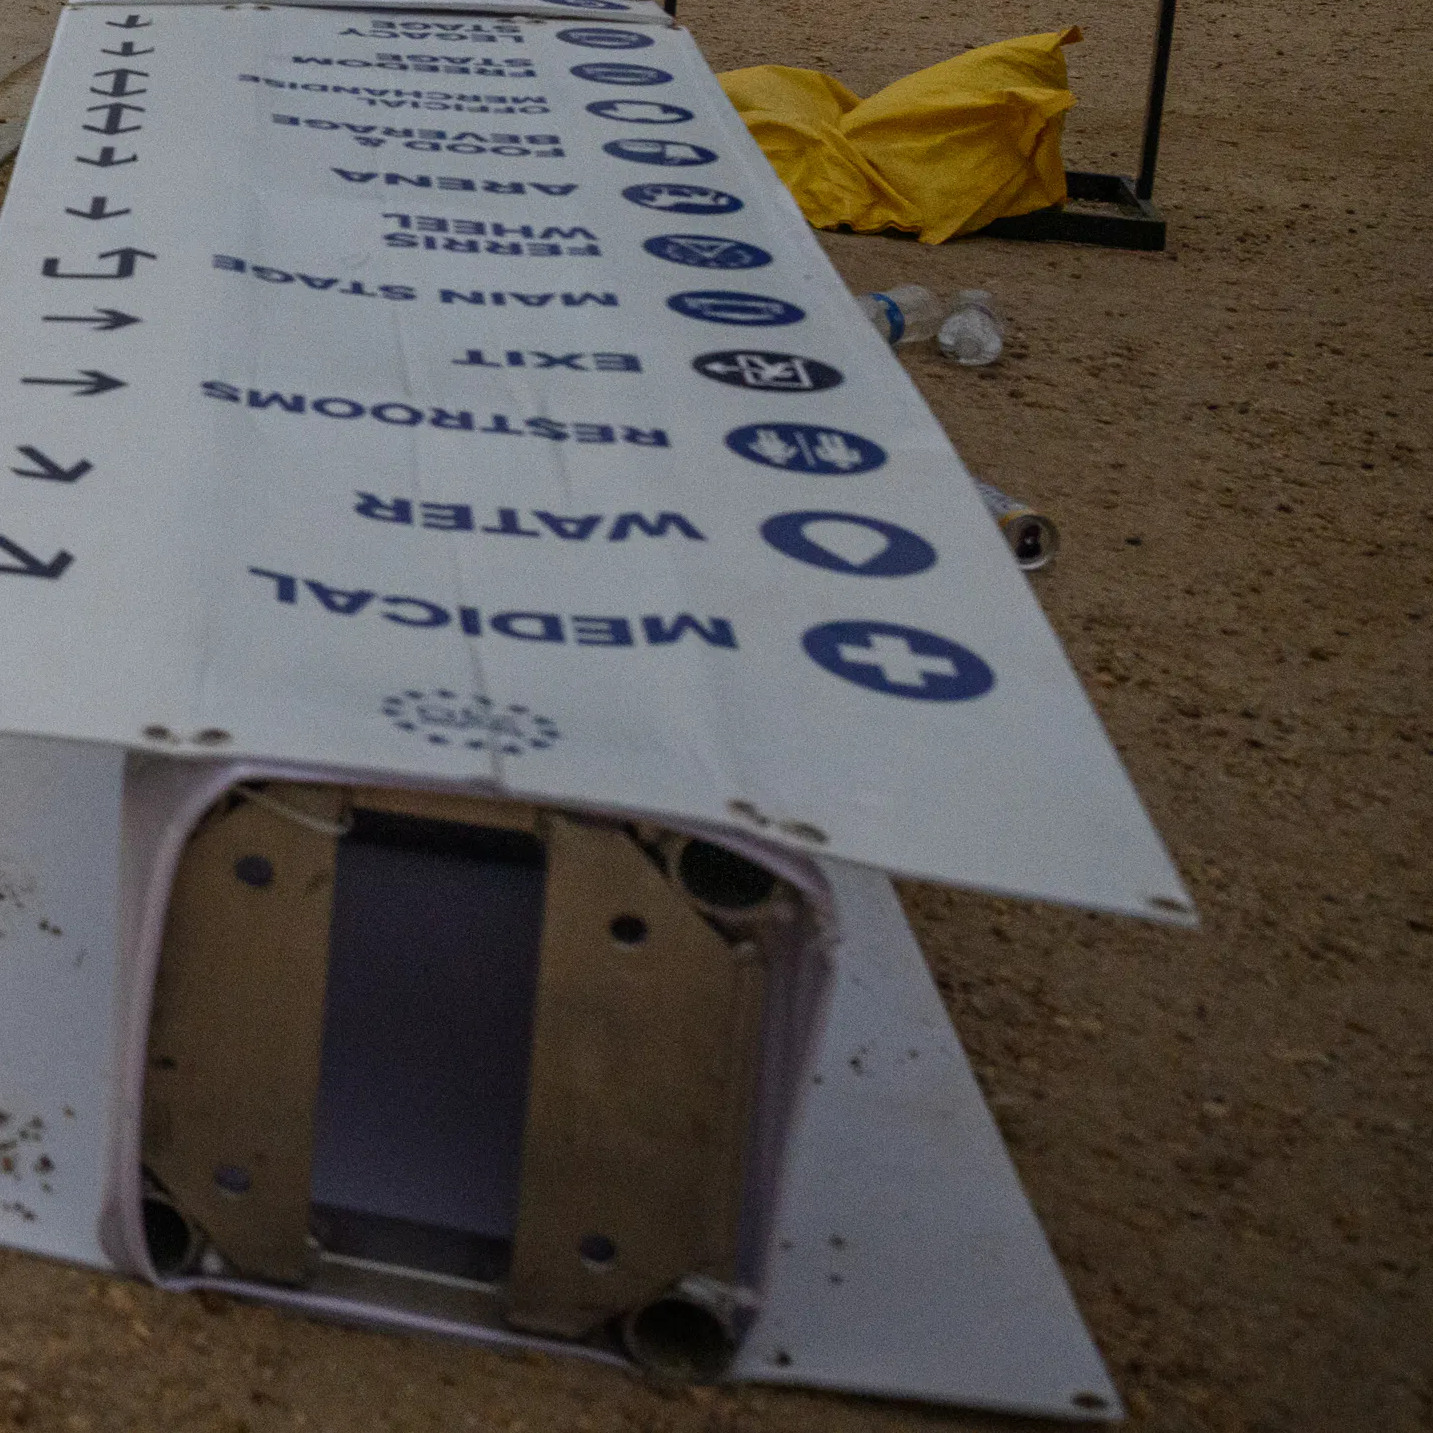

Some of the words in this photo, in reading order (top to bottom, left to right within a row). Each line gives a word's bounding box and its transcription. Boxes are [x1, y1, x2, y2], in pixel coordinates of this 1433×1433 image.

[338, 28, 525, 44] LEGACY
[370, 20, 521, 33] STAGE
[291, 56, 538, 78] FREEDOM
[375, 53, 534, 66] STAGE
[237, 74, 548, 104] MERCHANDISE
[356, 97, 551, 114] OFFICIAL
[271, 113, 561, 145] BEVERAGE
[353, 136, 387, 148] &
[403, 140, 566, 157] FOOD
[329, 166, 579, 196] ARENA
[381, 212, 599, 240] WHEEL
[382, 232, 603, 257] FERRIS
[211, 254, 418, 300] STAGE
[437, 289, 620, 307] MAIN
[449, 349, 644, 373] EXIT
[199, 381, 672, 447] RESTROOMS
[353, 490, 709, 543] WATER
[246, 567, 740, 652] MEDICAL
